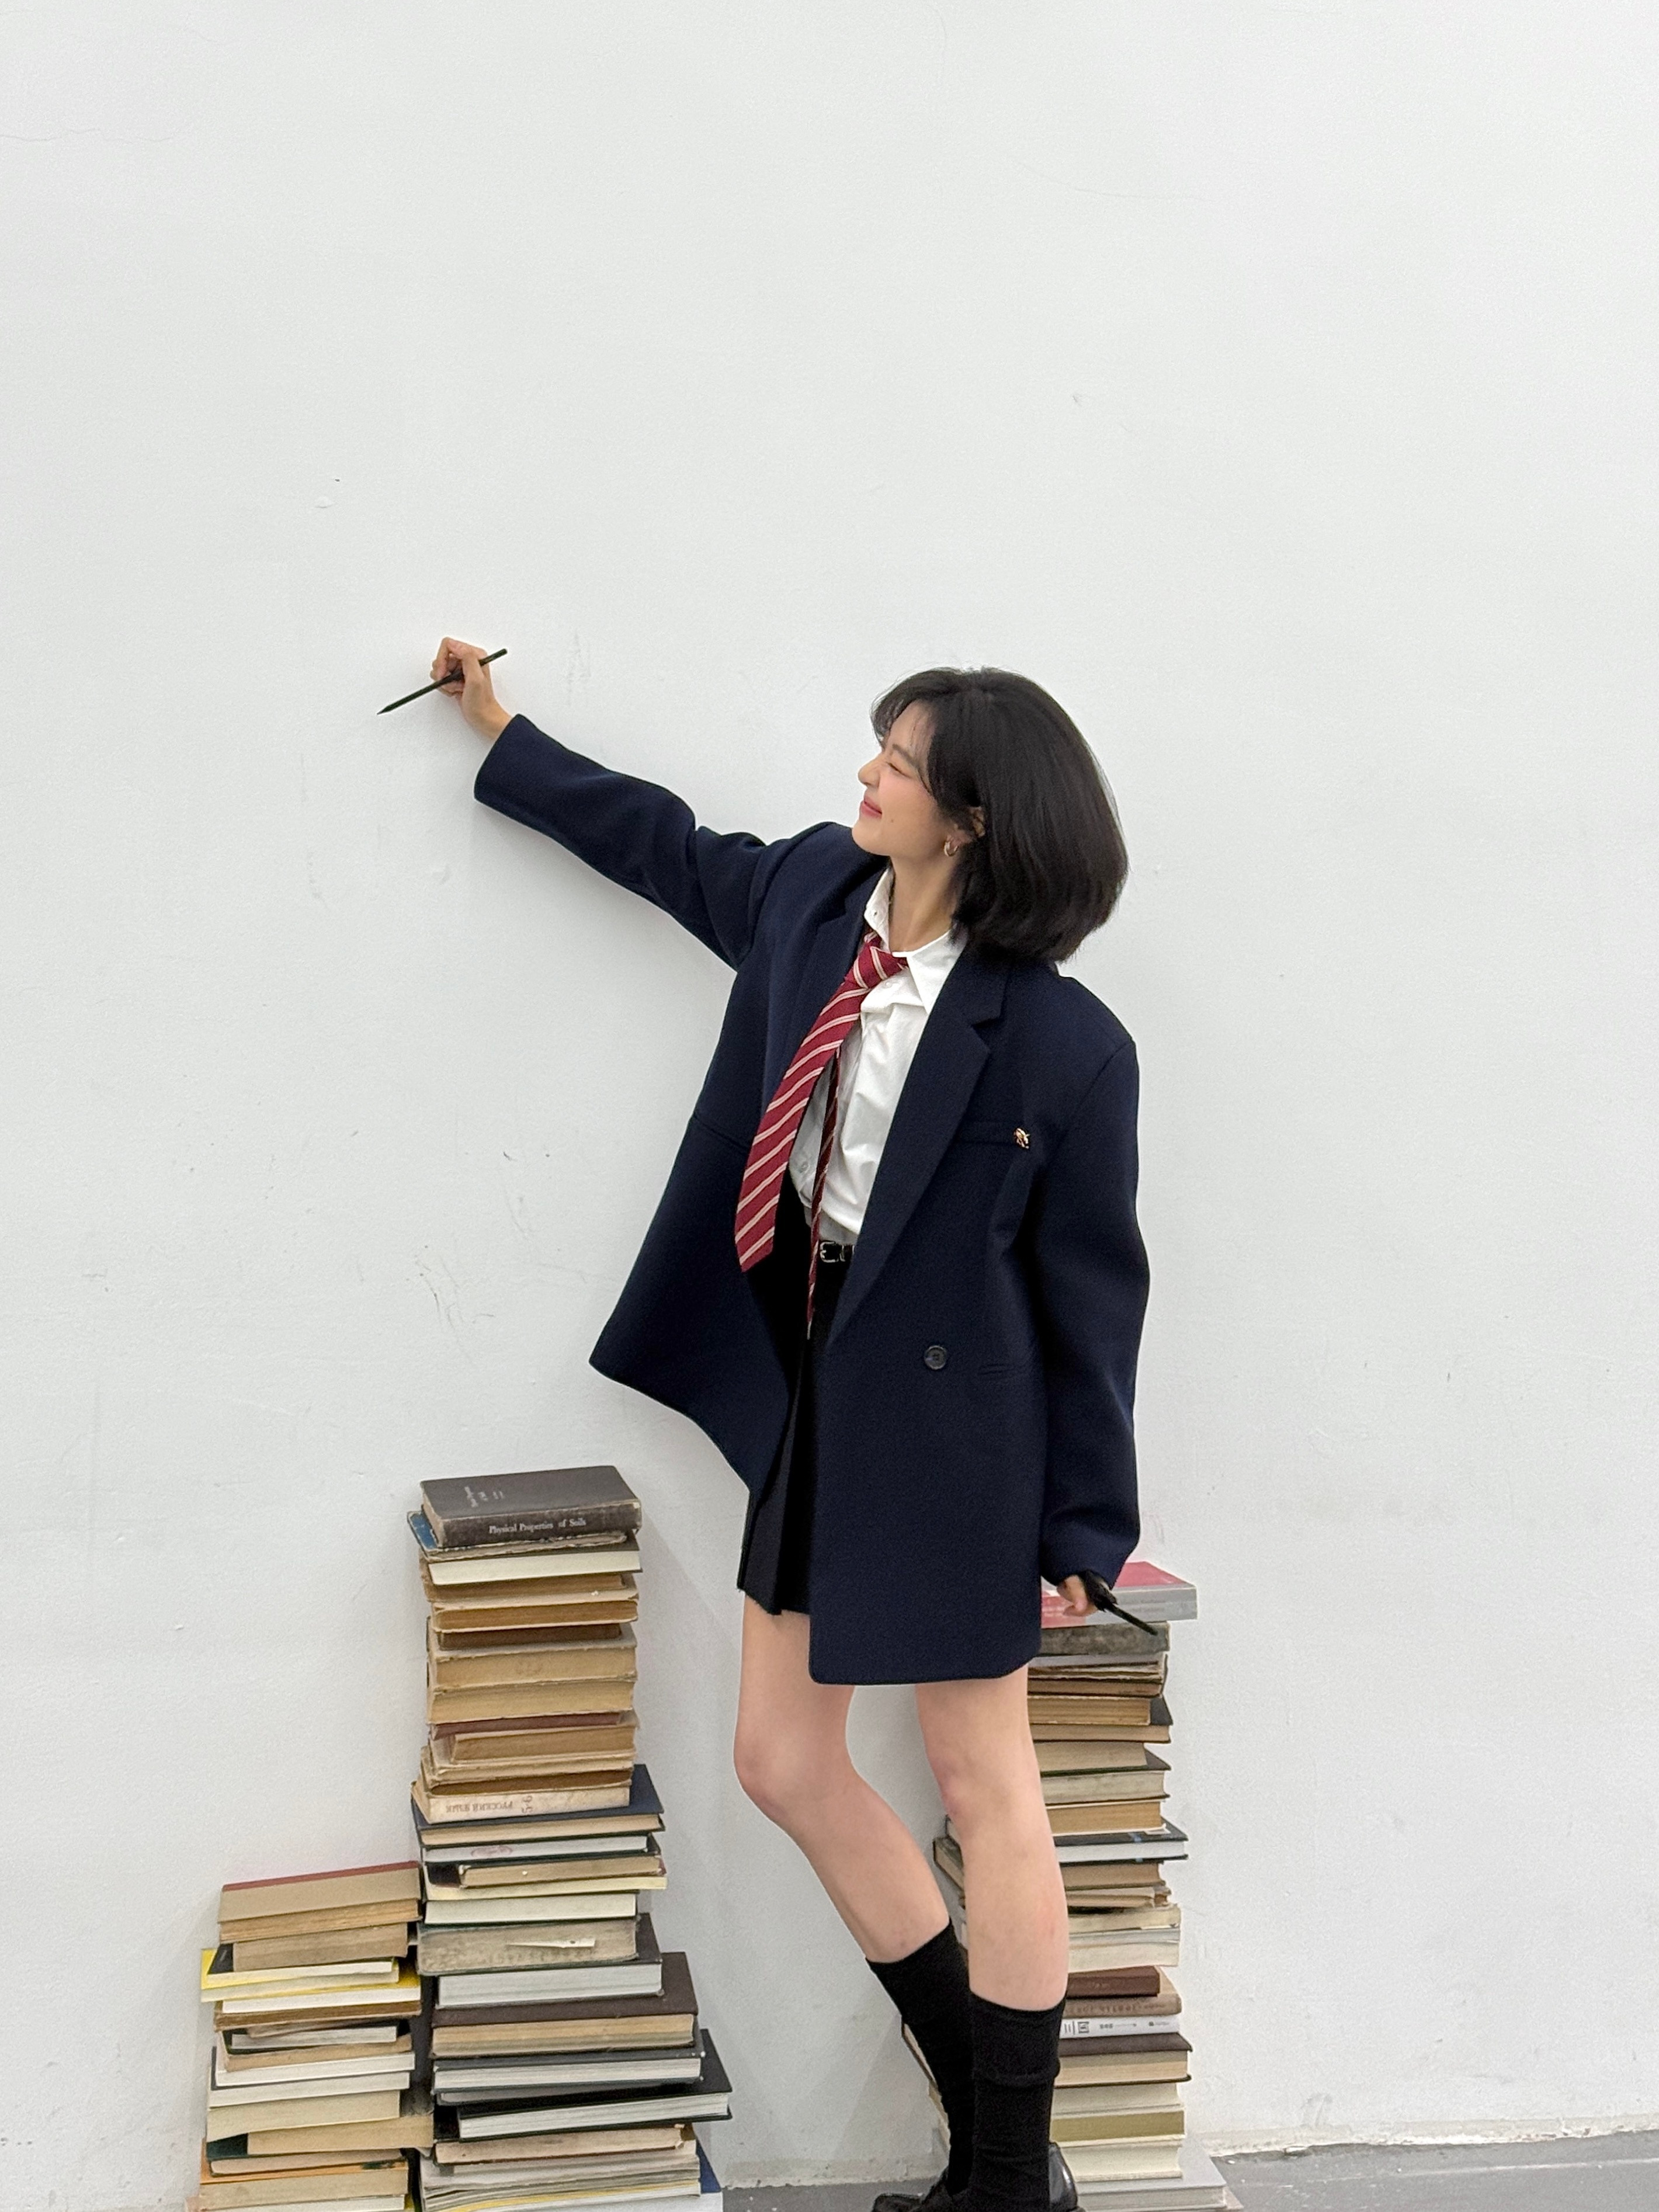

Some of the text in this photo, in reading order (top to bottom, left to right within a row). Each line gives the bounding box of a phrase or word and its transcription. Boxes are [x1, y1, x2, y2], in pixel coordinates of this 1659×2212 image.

[489, 1518, 586, 1535] Physical Properties of Soils
